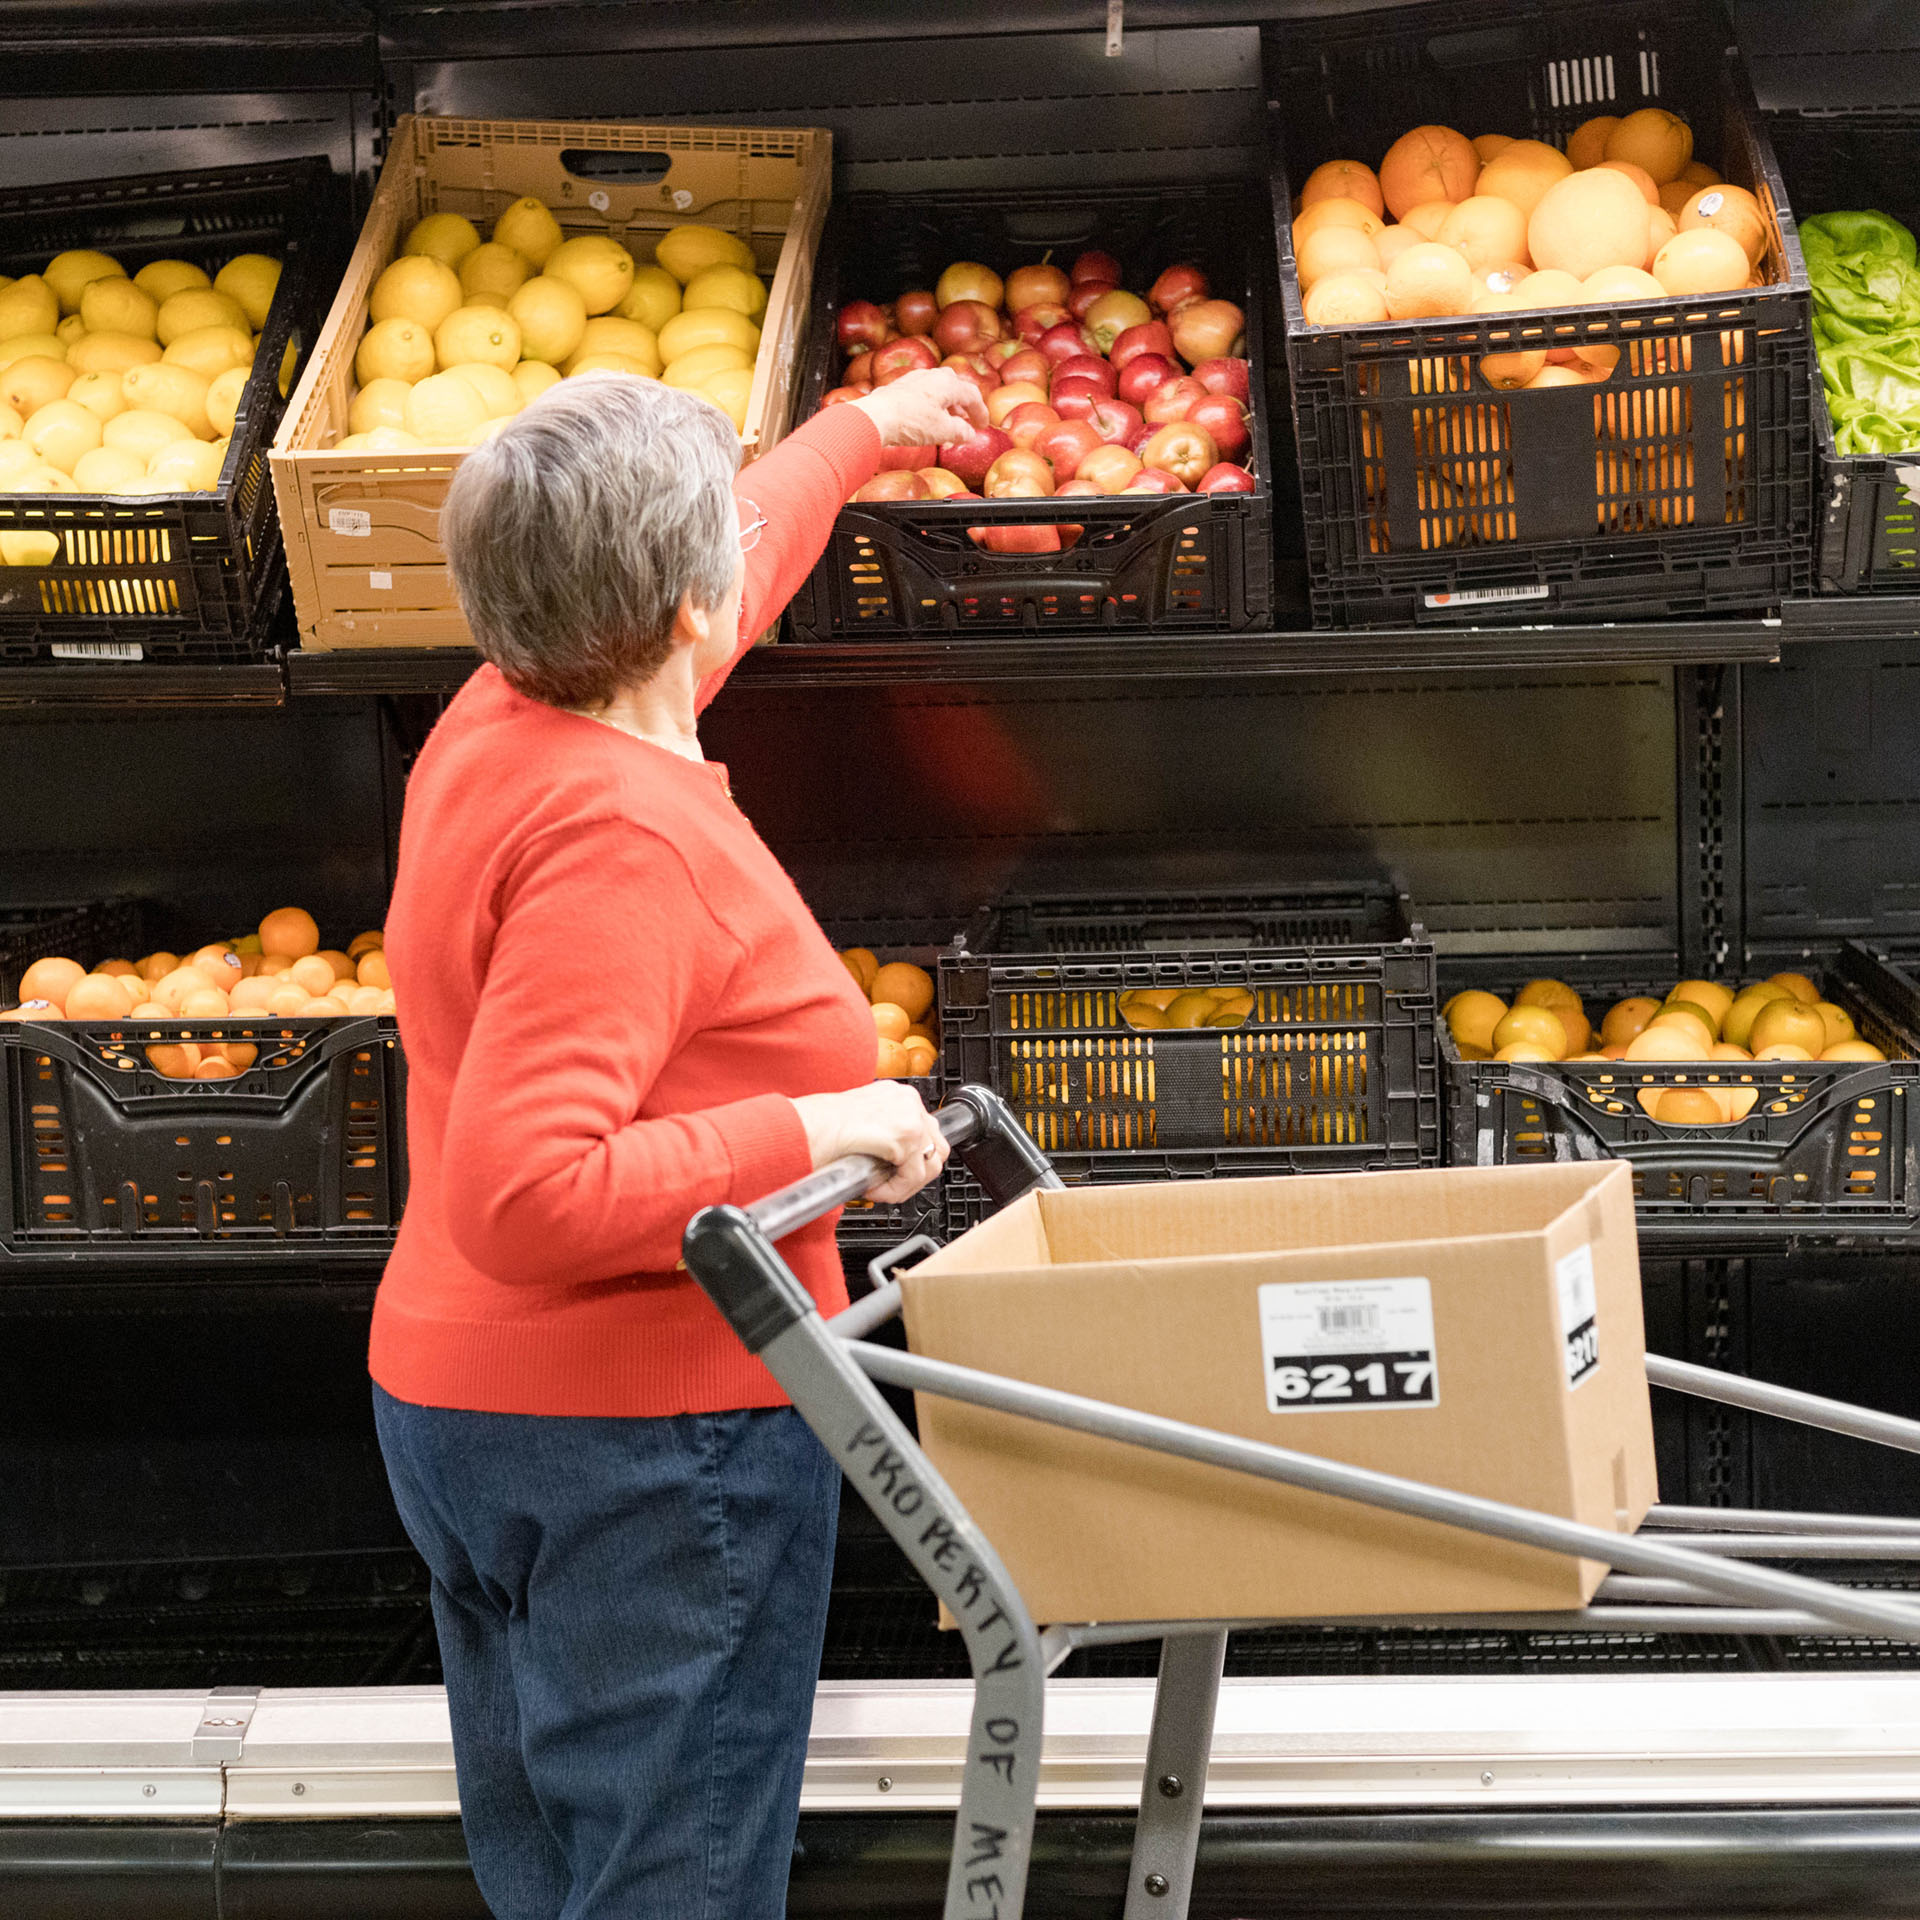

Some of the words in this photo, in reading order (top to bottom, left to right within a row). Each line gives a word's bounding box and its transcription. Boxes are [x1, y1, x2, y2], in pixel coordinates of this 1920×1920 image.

[1273, 1362, 1433, 1399] 6217
[848, 1421, 1026, 1679] PROPERTY
[979, 1718, 1020, 1785] OF
